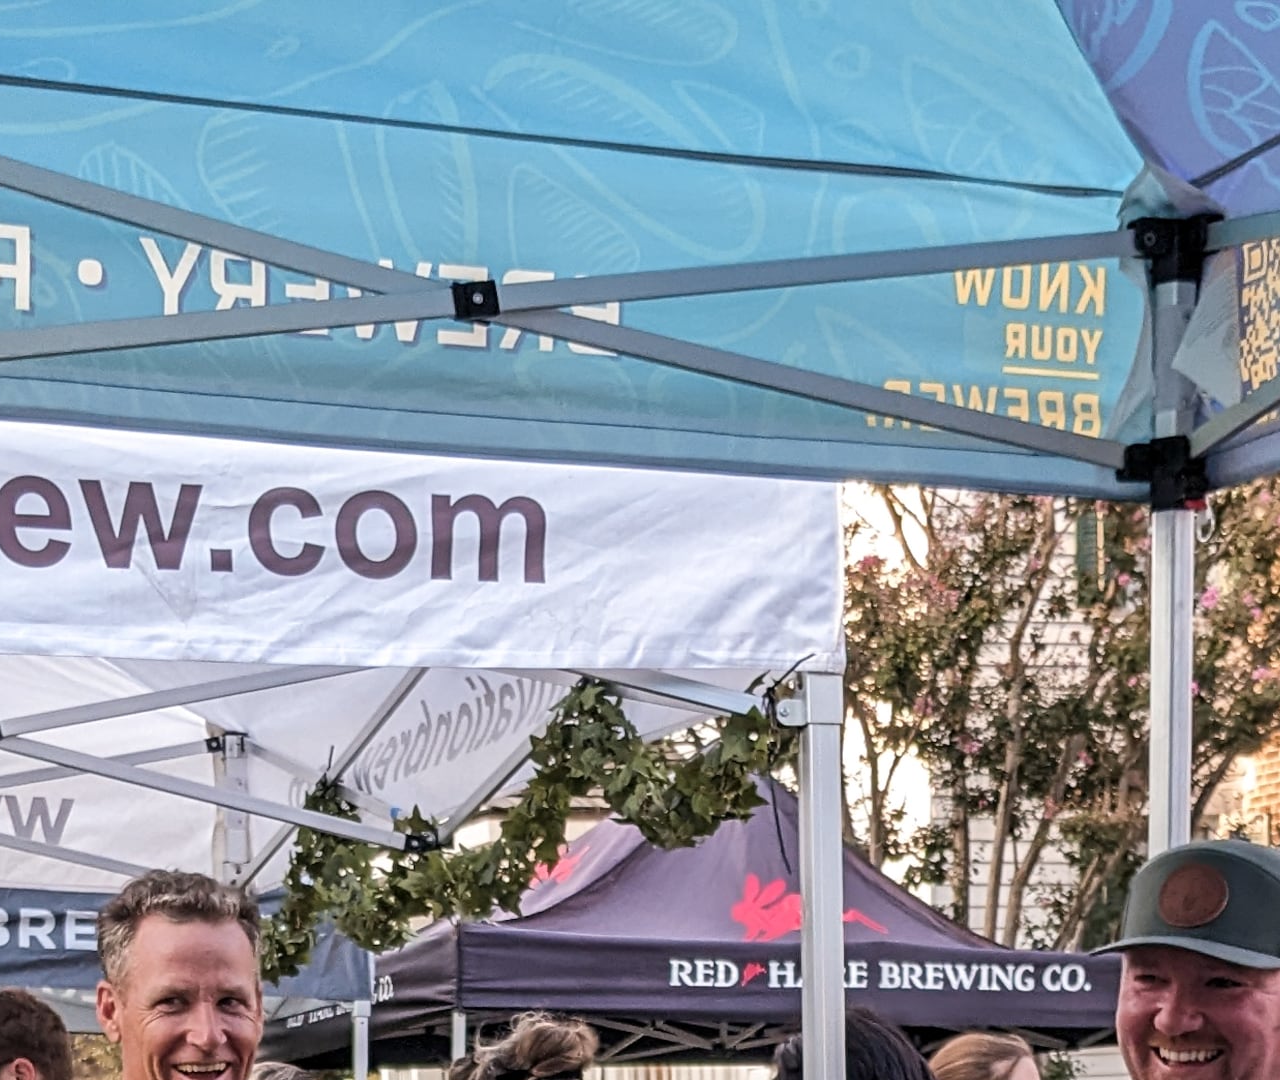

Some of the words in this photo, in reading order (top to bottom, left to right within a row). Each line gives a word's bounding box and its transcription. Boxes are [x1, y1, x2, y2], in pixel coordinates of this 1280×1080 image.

[669, 960, 738, 988] RED
[768, 961, 868, 989] HE
[878, 962, 1034, 991] BREWING
[1041, 965, 1092, 992] CO.
